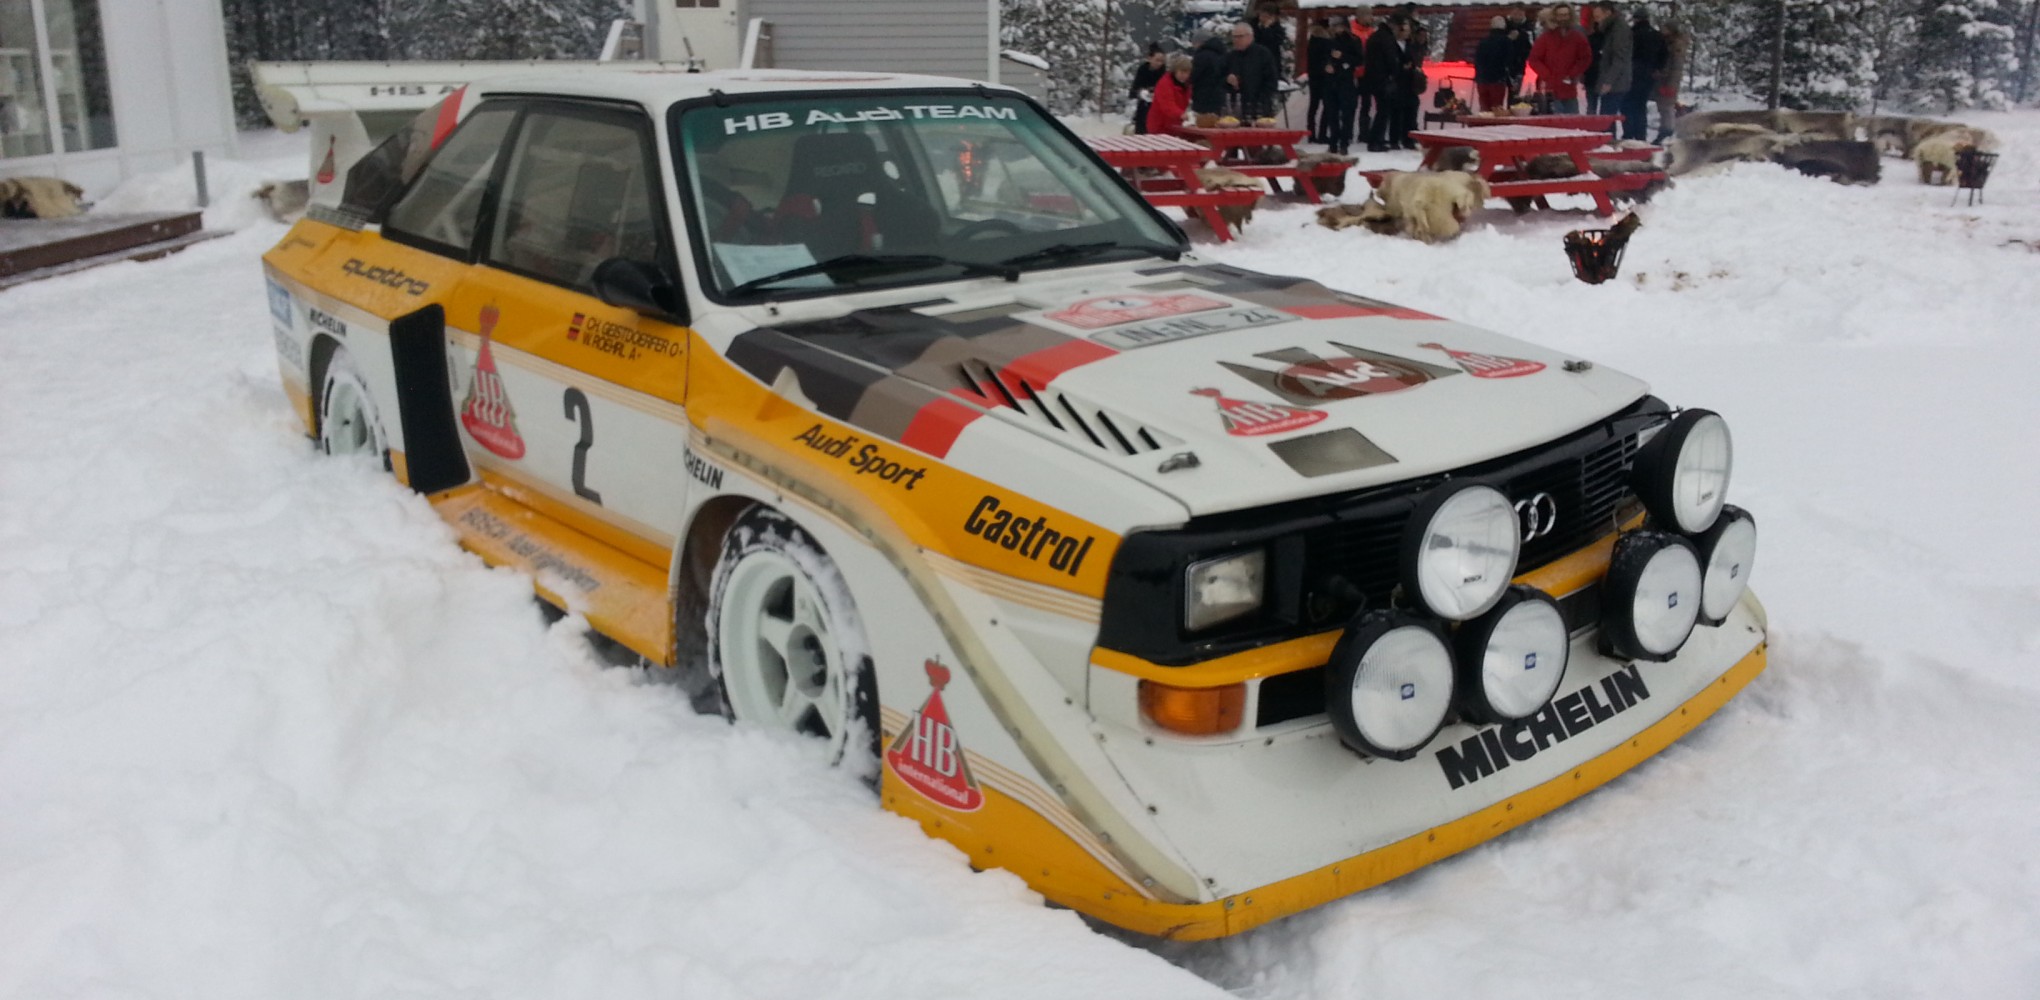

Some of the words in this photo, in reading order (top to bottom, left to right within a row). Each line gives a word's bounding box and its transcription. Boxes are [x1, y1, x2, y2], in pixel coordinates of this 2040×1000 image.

[723, 112, 794, 136] HB
[904, 104, 1019, 122] TEAM
[341, 257, 431, 297] quattro
[309, 307, 348, 338] MICHELIN
[1219, 403, 1292, 427] HB
[563, 386, 605, 507] 2
[792, 423, 852, 459] Audi
[849, 443, 928, 491] Sport
[963, 494, 1095, 577] Castrol
[911, 709, 959, 779] HB
[1435, 664, 1651, 790] MICHELIN
[897, 760, 969, 808] international
